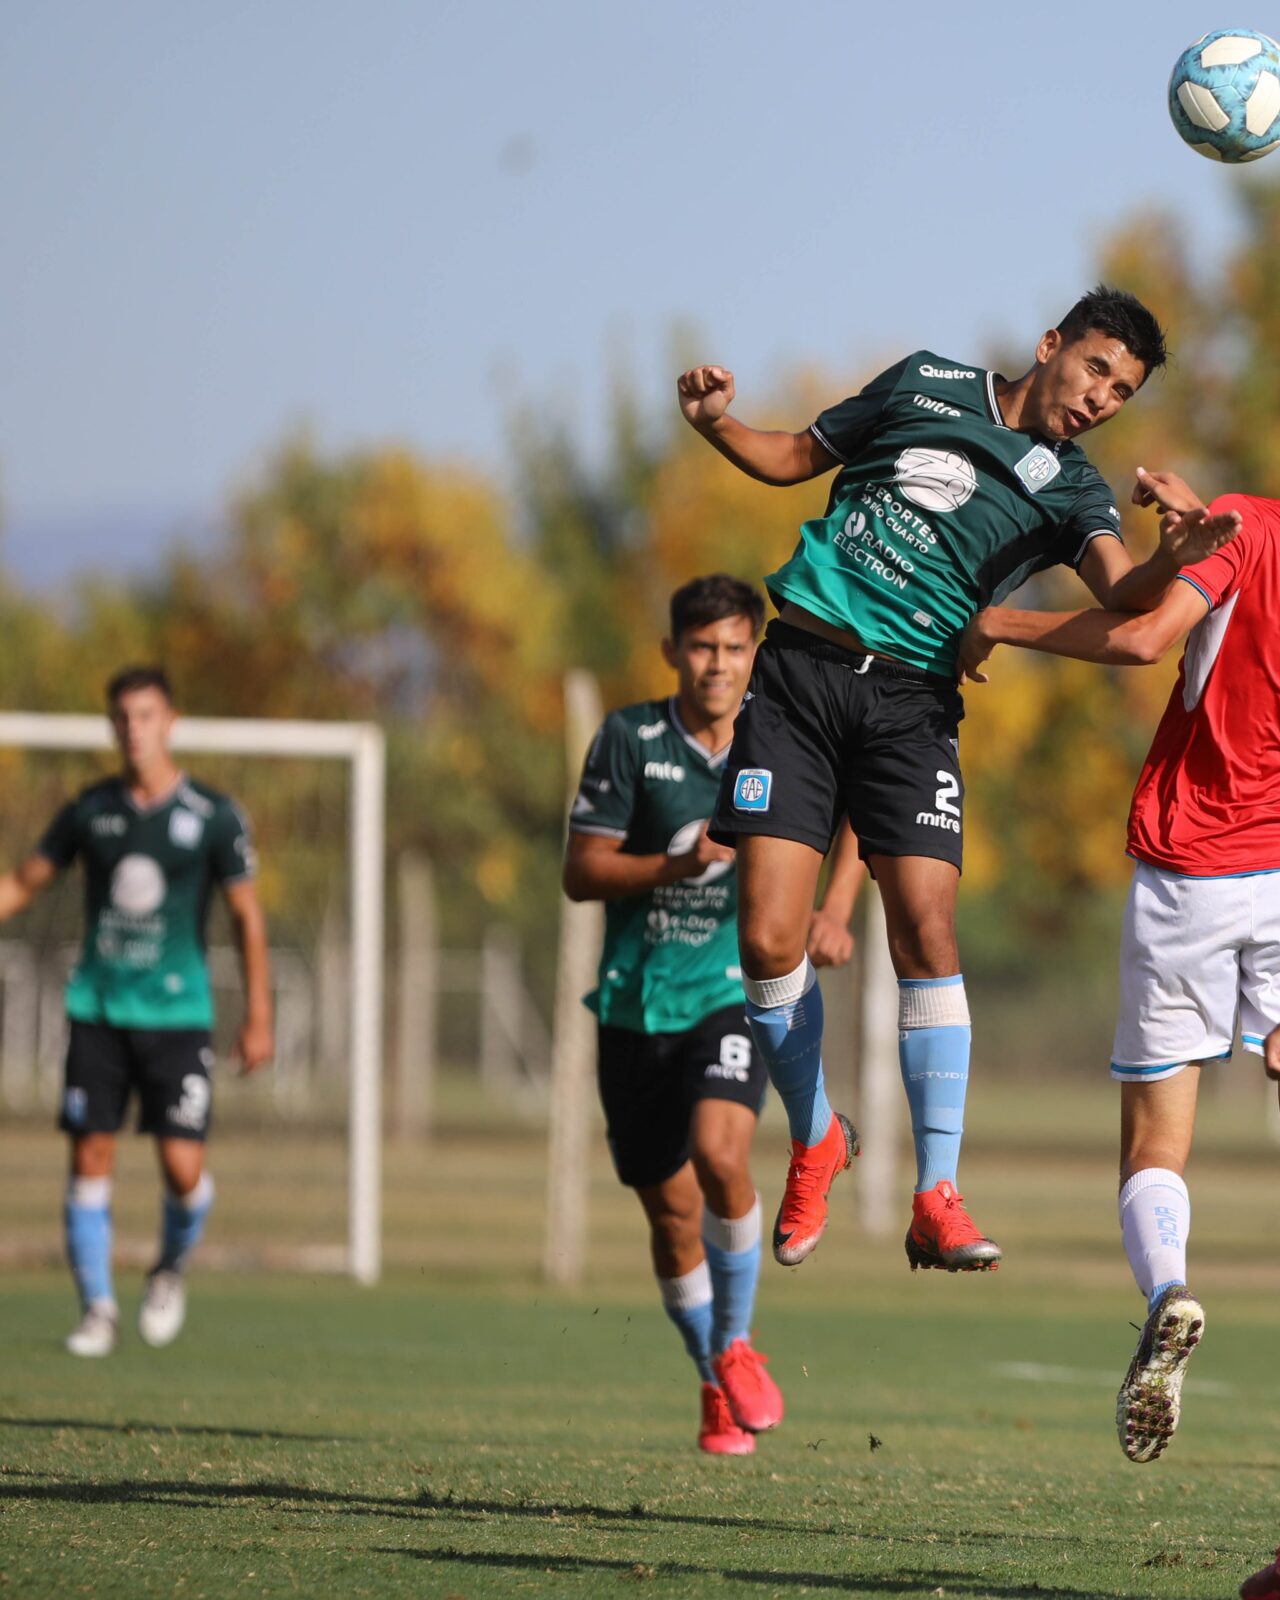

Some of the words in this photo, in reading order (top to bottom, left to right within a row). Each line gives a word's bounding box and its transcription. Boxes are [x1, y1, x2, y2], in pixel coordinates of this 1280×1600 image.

[919, 364, 976, 379] Quatro
[913, 394, 961, 417] mitre
[865, 482, 939, 545] DEPORTES
[861, 530, 915, 573] RADIO
[885, 517, 929, 554] CUARTO
[833, 531, 908, 590] ELECTRON
[935, 769, 961, 818] 2
[916, 810, 961, 834] mitre
[720, 1034, 752, 1069] 6
